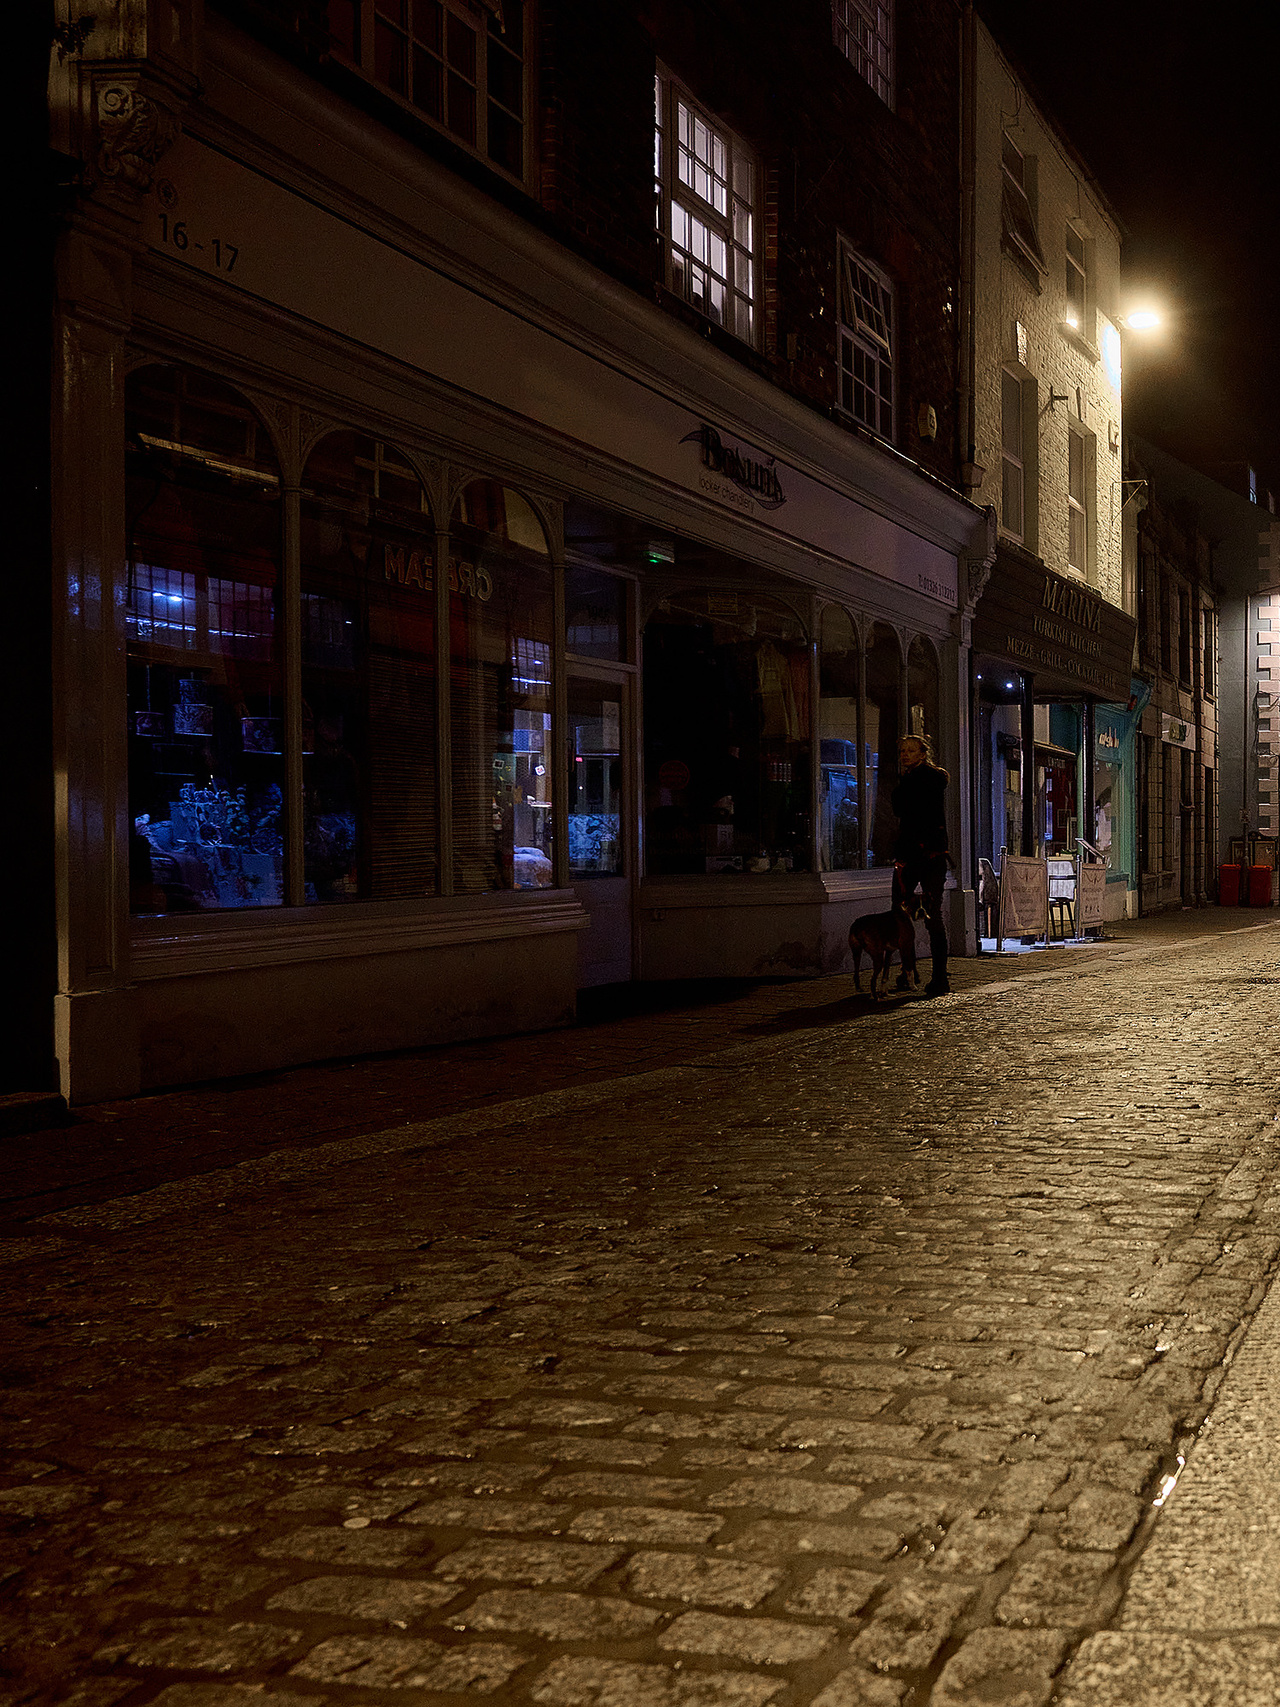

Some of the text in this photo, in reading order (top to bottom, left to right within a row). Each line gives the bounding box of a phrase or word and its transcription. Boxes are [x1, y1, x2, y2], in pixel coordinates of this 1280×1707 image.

[157, 213, 240, 273] 16-17
[1042, 576, 1102, 634] MARINA
[1006, 635, 1034, 660] MEZZE
[1033, 615, 1102, 658] TURKISH KITCHEN
